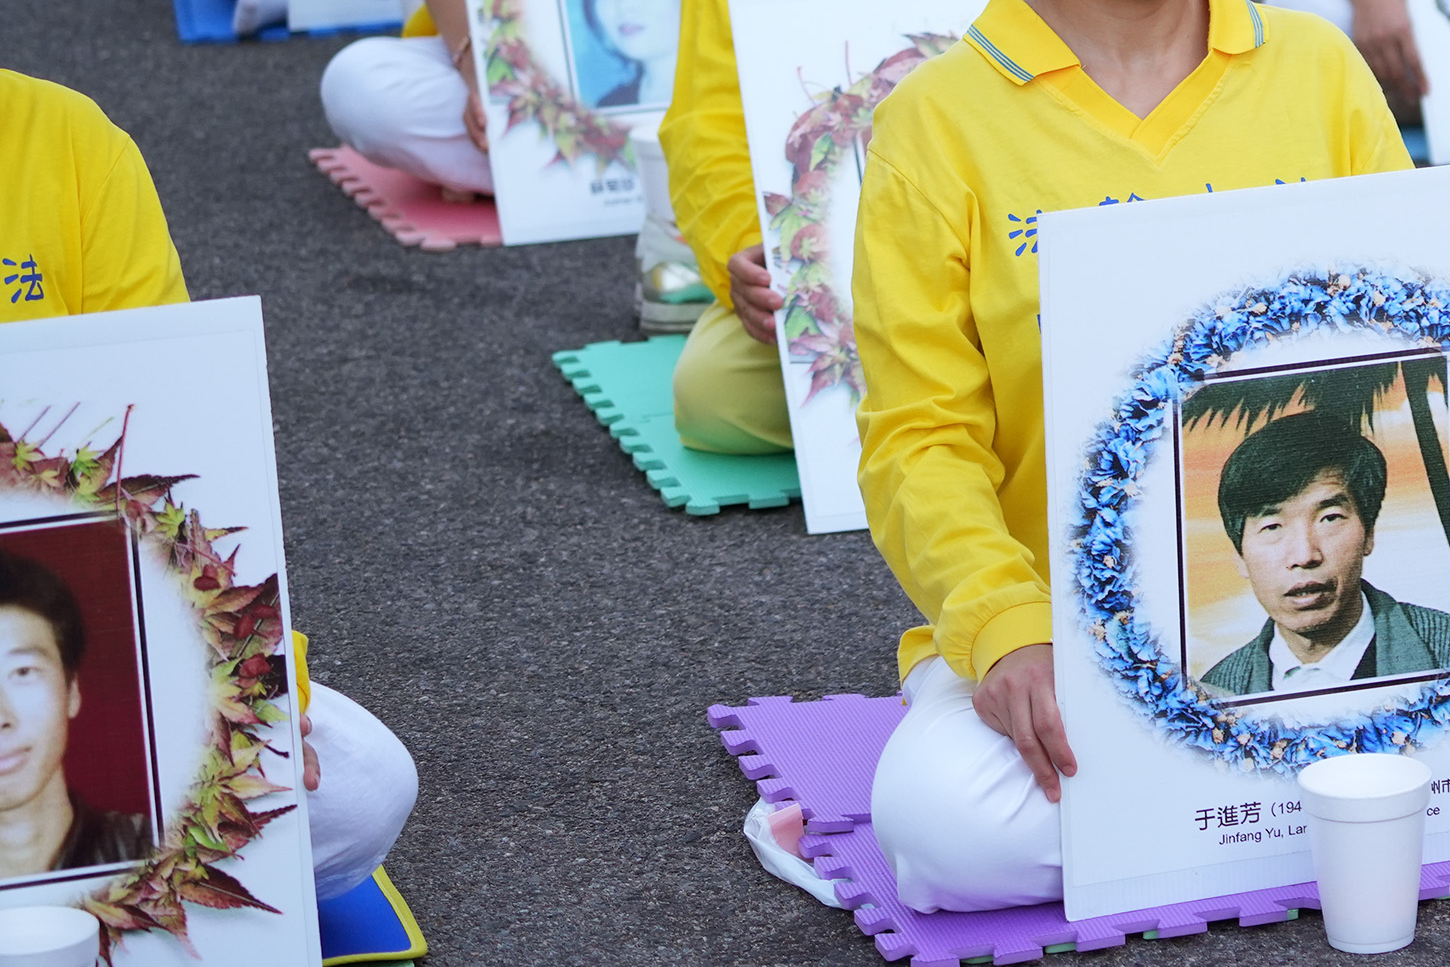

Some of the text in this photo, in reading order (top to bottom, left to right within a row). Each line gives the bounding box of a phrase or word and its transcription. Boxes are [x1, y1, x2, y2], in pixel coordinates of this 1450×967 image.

[2, 254, 45, 304] 法
[1218, 829, 1262, 845] Jinfang
[1265, 827, 1284, 838] Yu,
